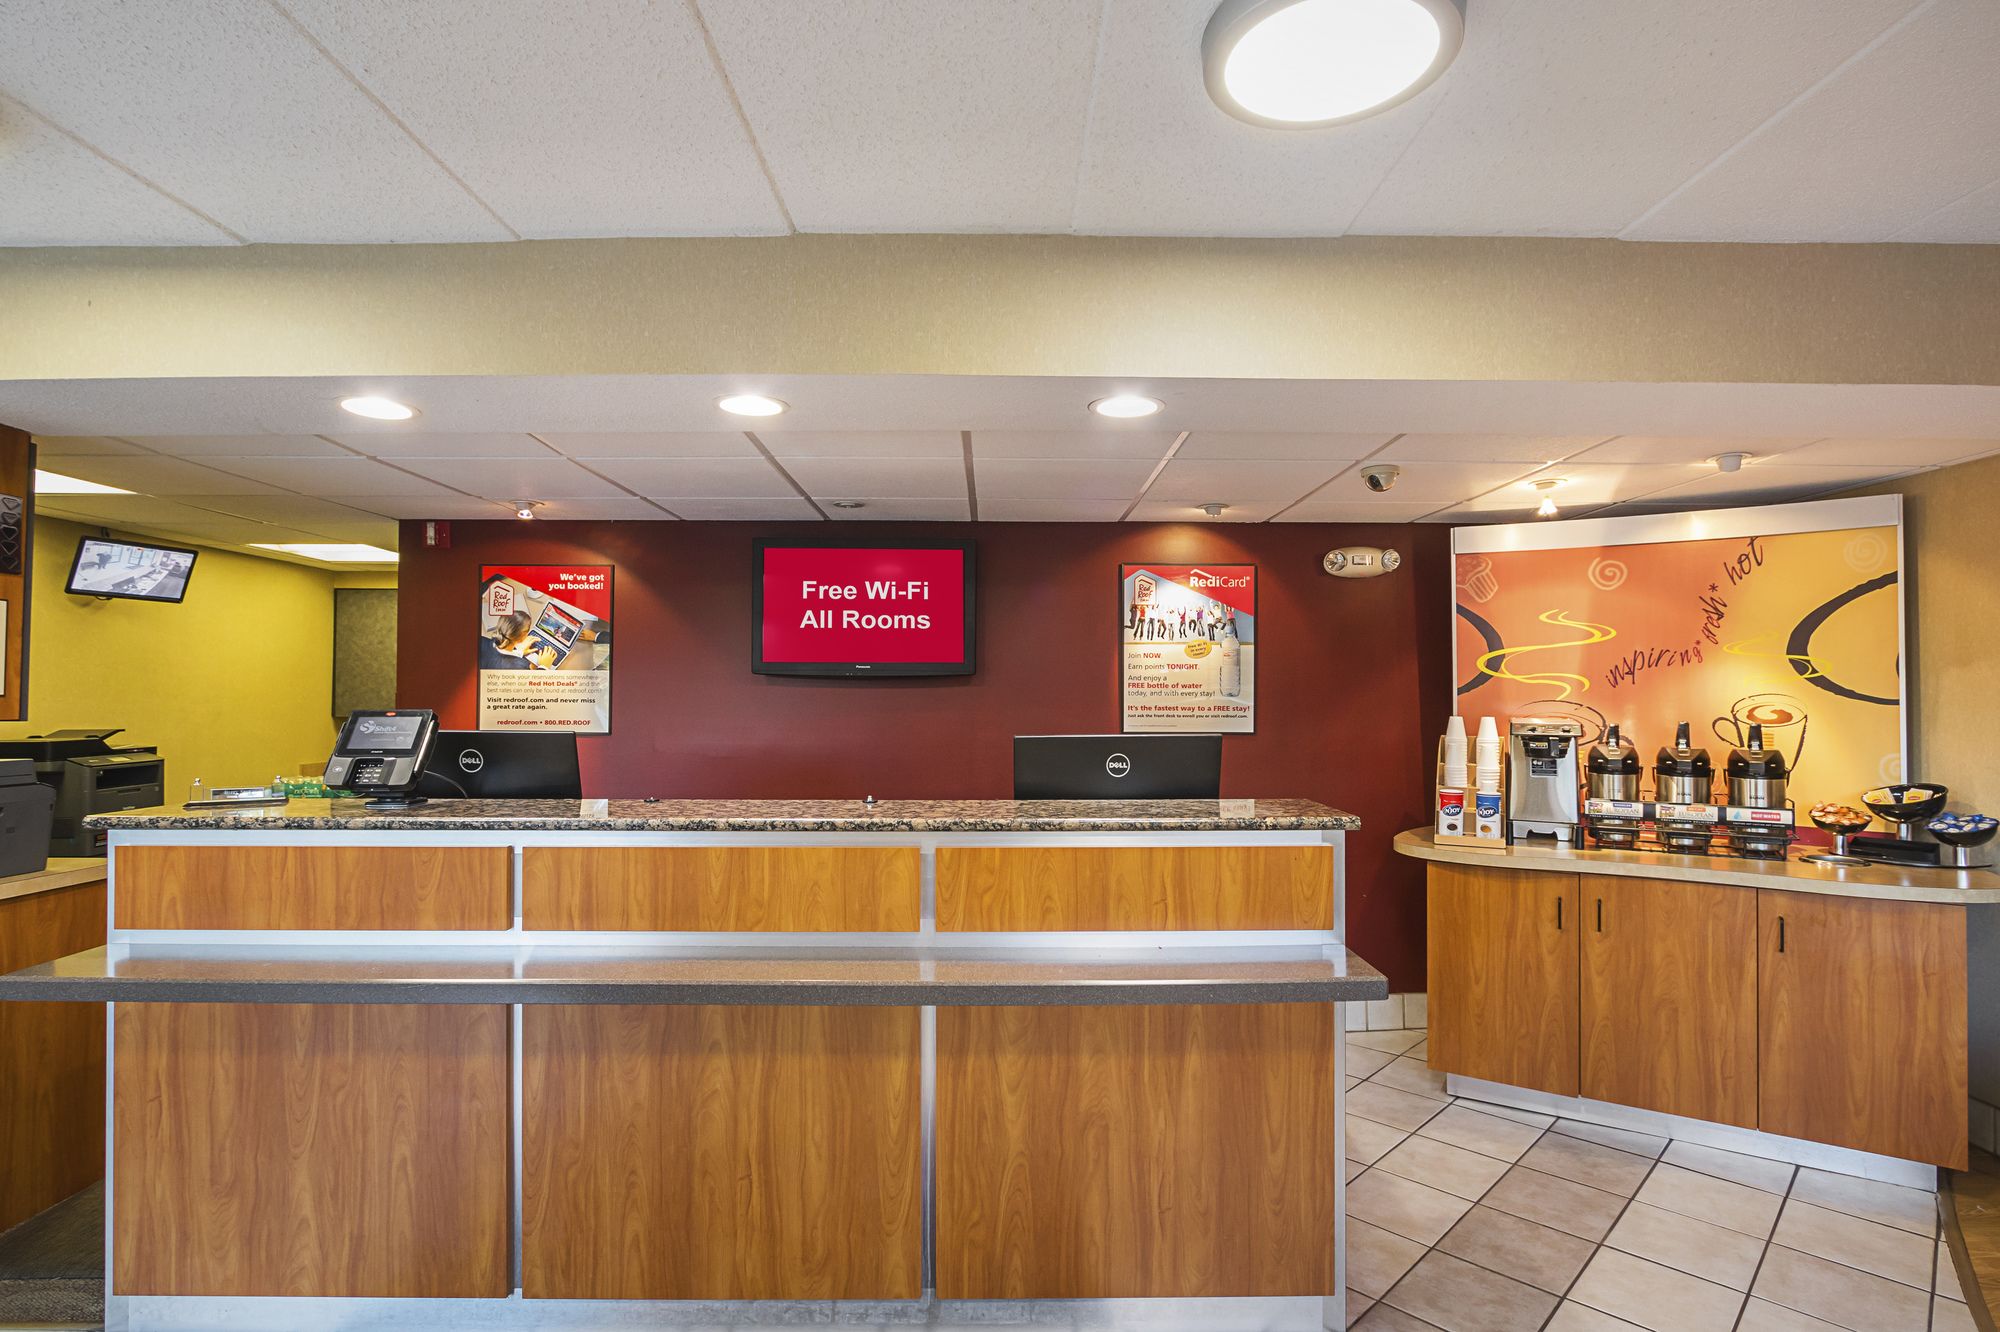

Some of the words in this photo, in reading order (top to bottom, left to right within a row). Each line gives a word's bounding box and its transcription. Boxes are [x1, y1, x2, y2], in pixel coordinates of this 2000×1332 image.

[1724, 536, 1764, 586] hot
[588, 574, 604, 582] got
[494, 591, 508, 599] Red
[802, 580, 857, 600] Free
[864, 581, 929, 600] Wi-Fi
[1138, 590, 1153, 598] Roof
[493, 598, 510, 608] Roof
[800, 610, 832, 629] All
[842, 610, 931, 629] Rooms
